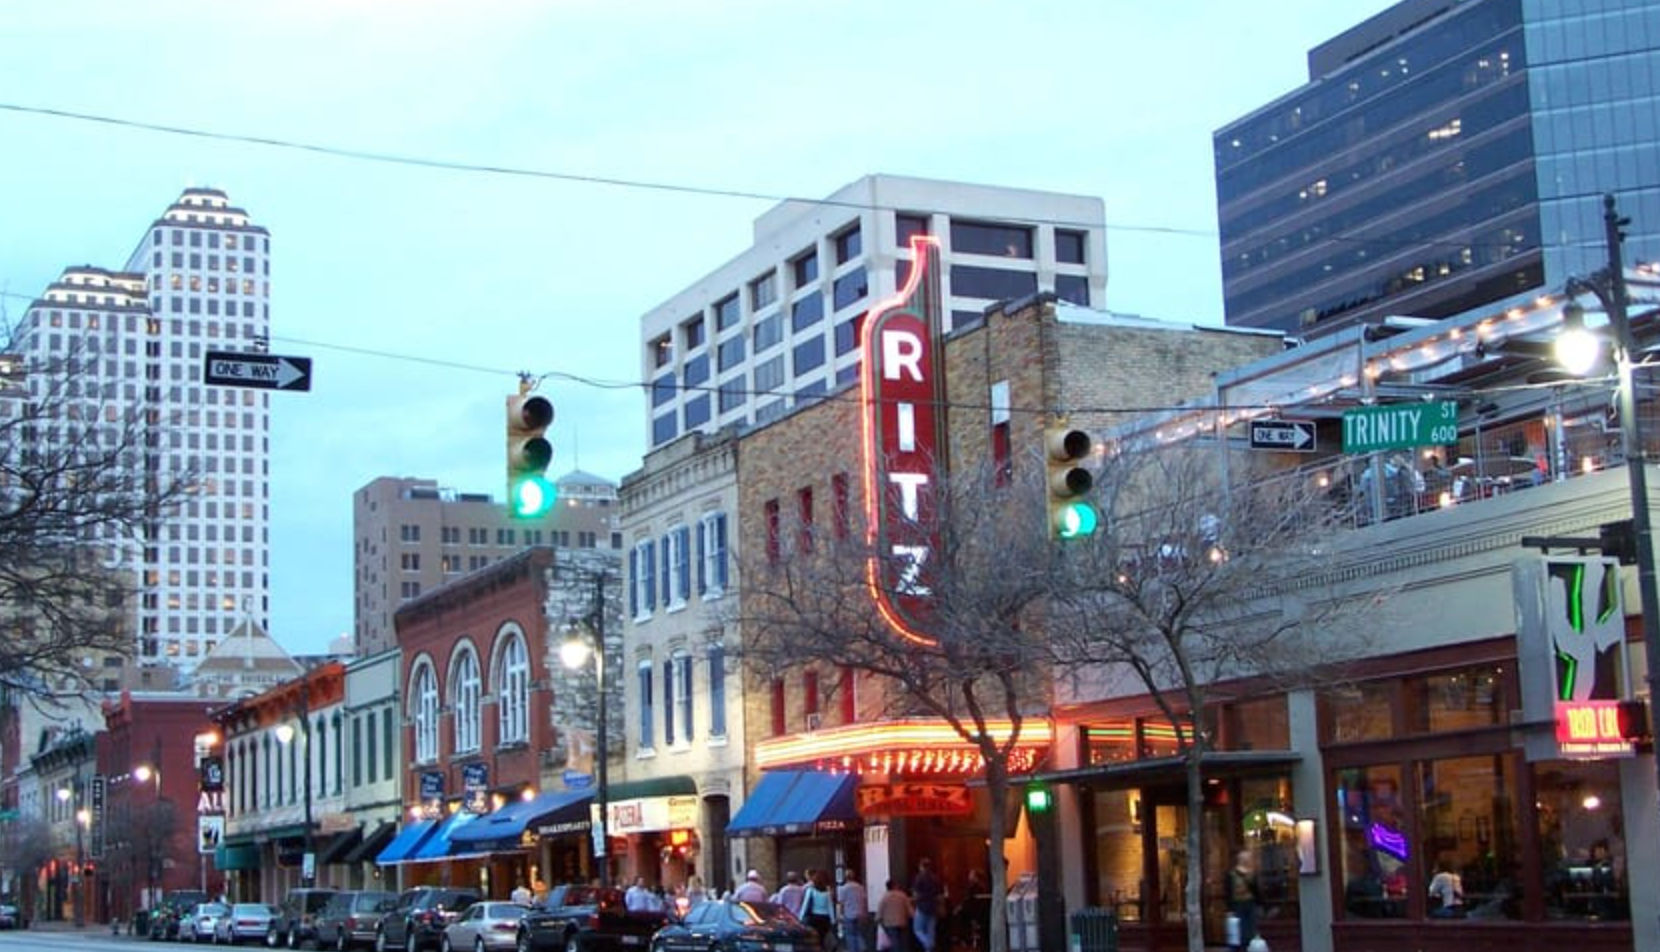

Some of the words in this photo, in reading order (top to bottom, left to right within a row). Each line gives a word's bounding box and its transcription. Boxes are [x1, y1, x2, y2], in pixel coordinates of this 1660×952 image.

[215, 362, 243, 377] ONE
[250, 364, 280, 378] WAY
[1345, 410, 1422, 447] TRINITY
[1441, 401, 1458, 419] ST
[1256, 429, 1274, 441] ONE
[1278, 430, 1296, 441] WAY
[1431, 426, 1458, 442] 600
[881, 329, 932, 597] RITZ
